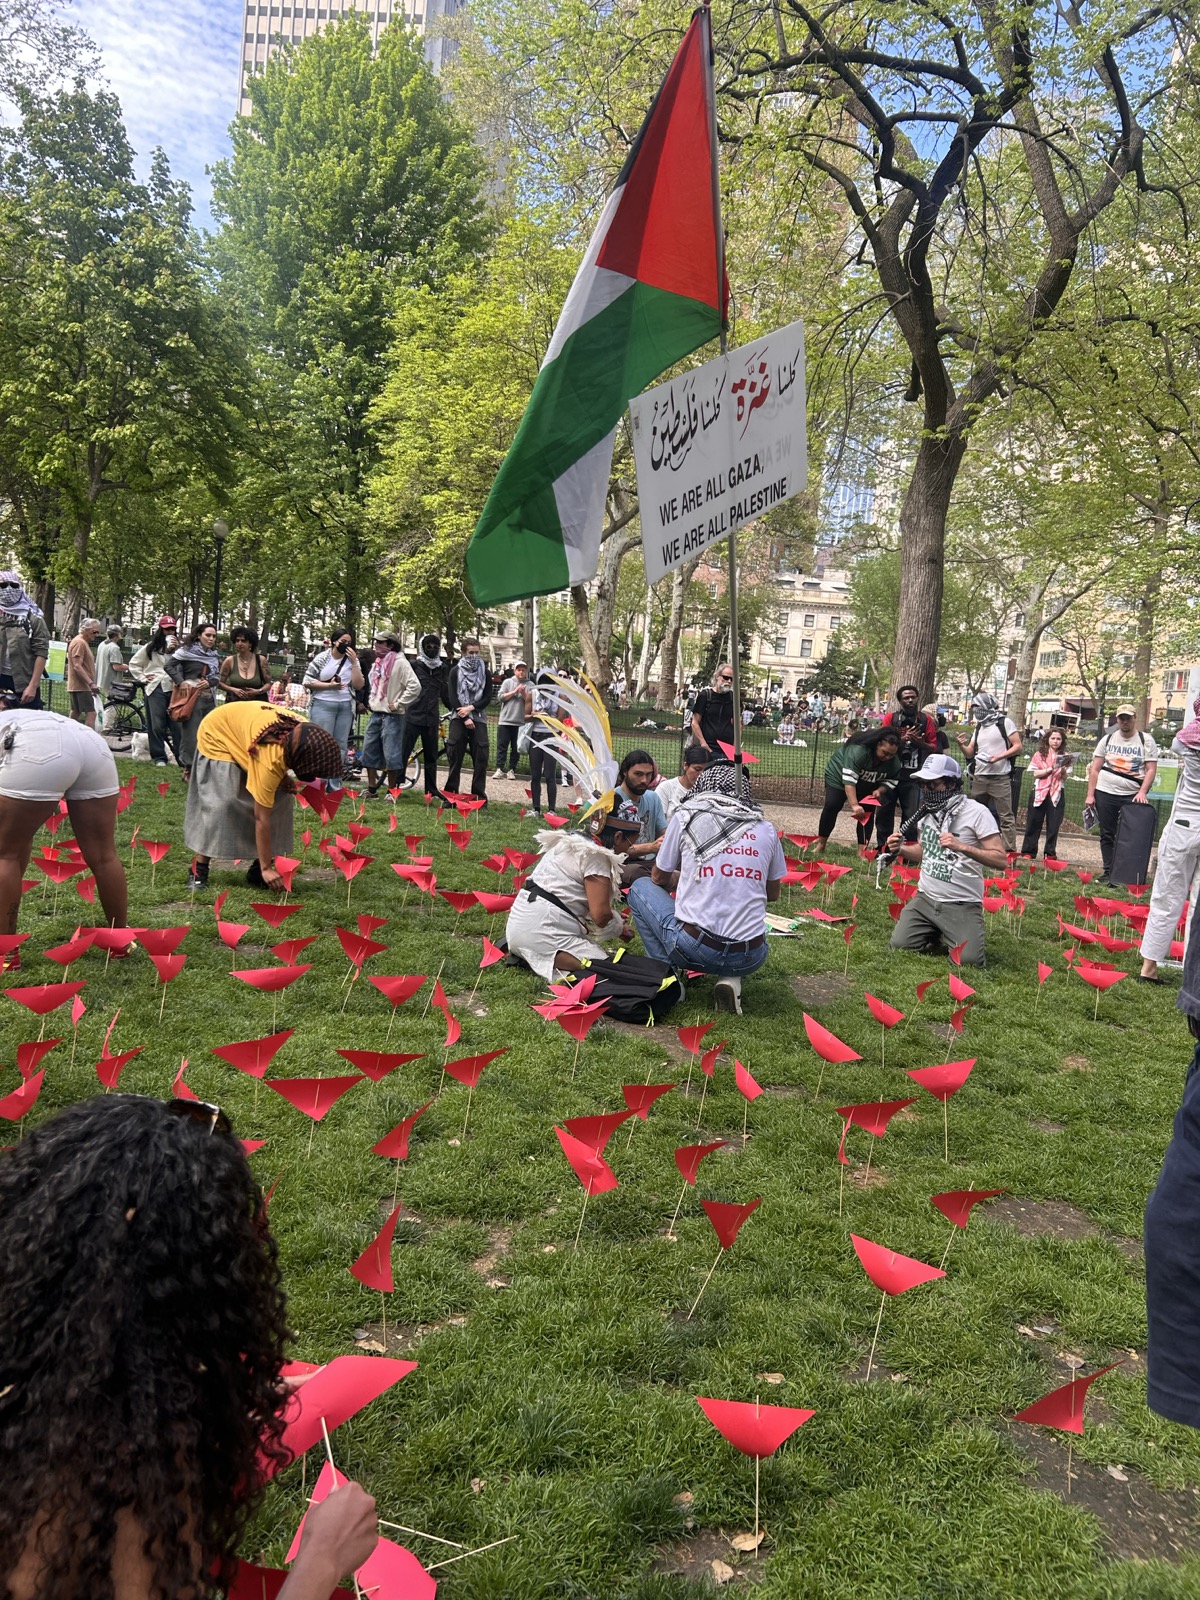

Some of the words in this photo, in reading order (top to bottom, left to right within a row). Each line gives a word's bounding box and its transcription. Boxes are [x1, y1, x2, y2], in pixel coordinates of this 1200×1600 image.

[659, 497, 679, 527] WE
[681, 485, 703, 516] ARE
[706, 474, 726, 502] ALL
[728, 453, 764, 489] GAZA,
[662, 538, 680, 566] WE
[683, 524, 705, 555] ARE
[707, 512, 727, 541] ALL
[729, 476, 787, 527] PALESTINE
[741, 831, 757, 841] he
[720, 863, 762, 881] Gaza
